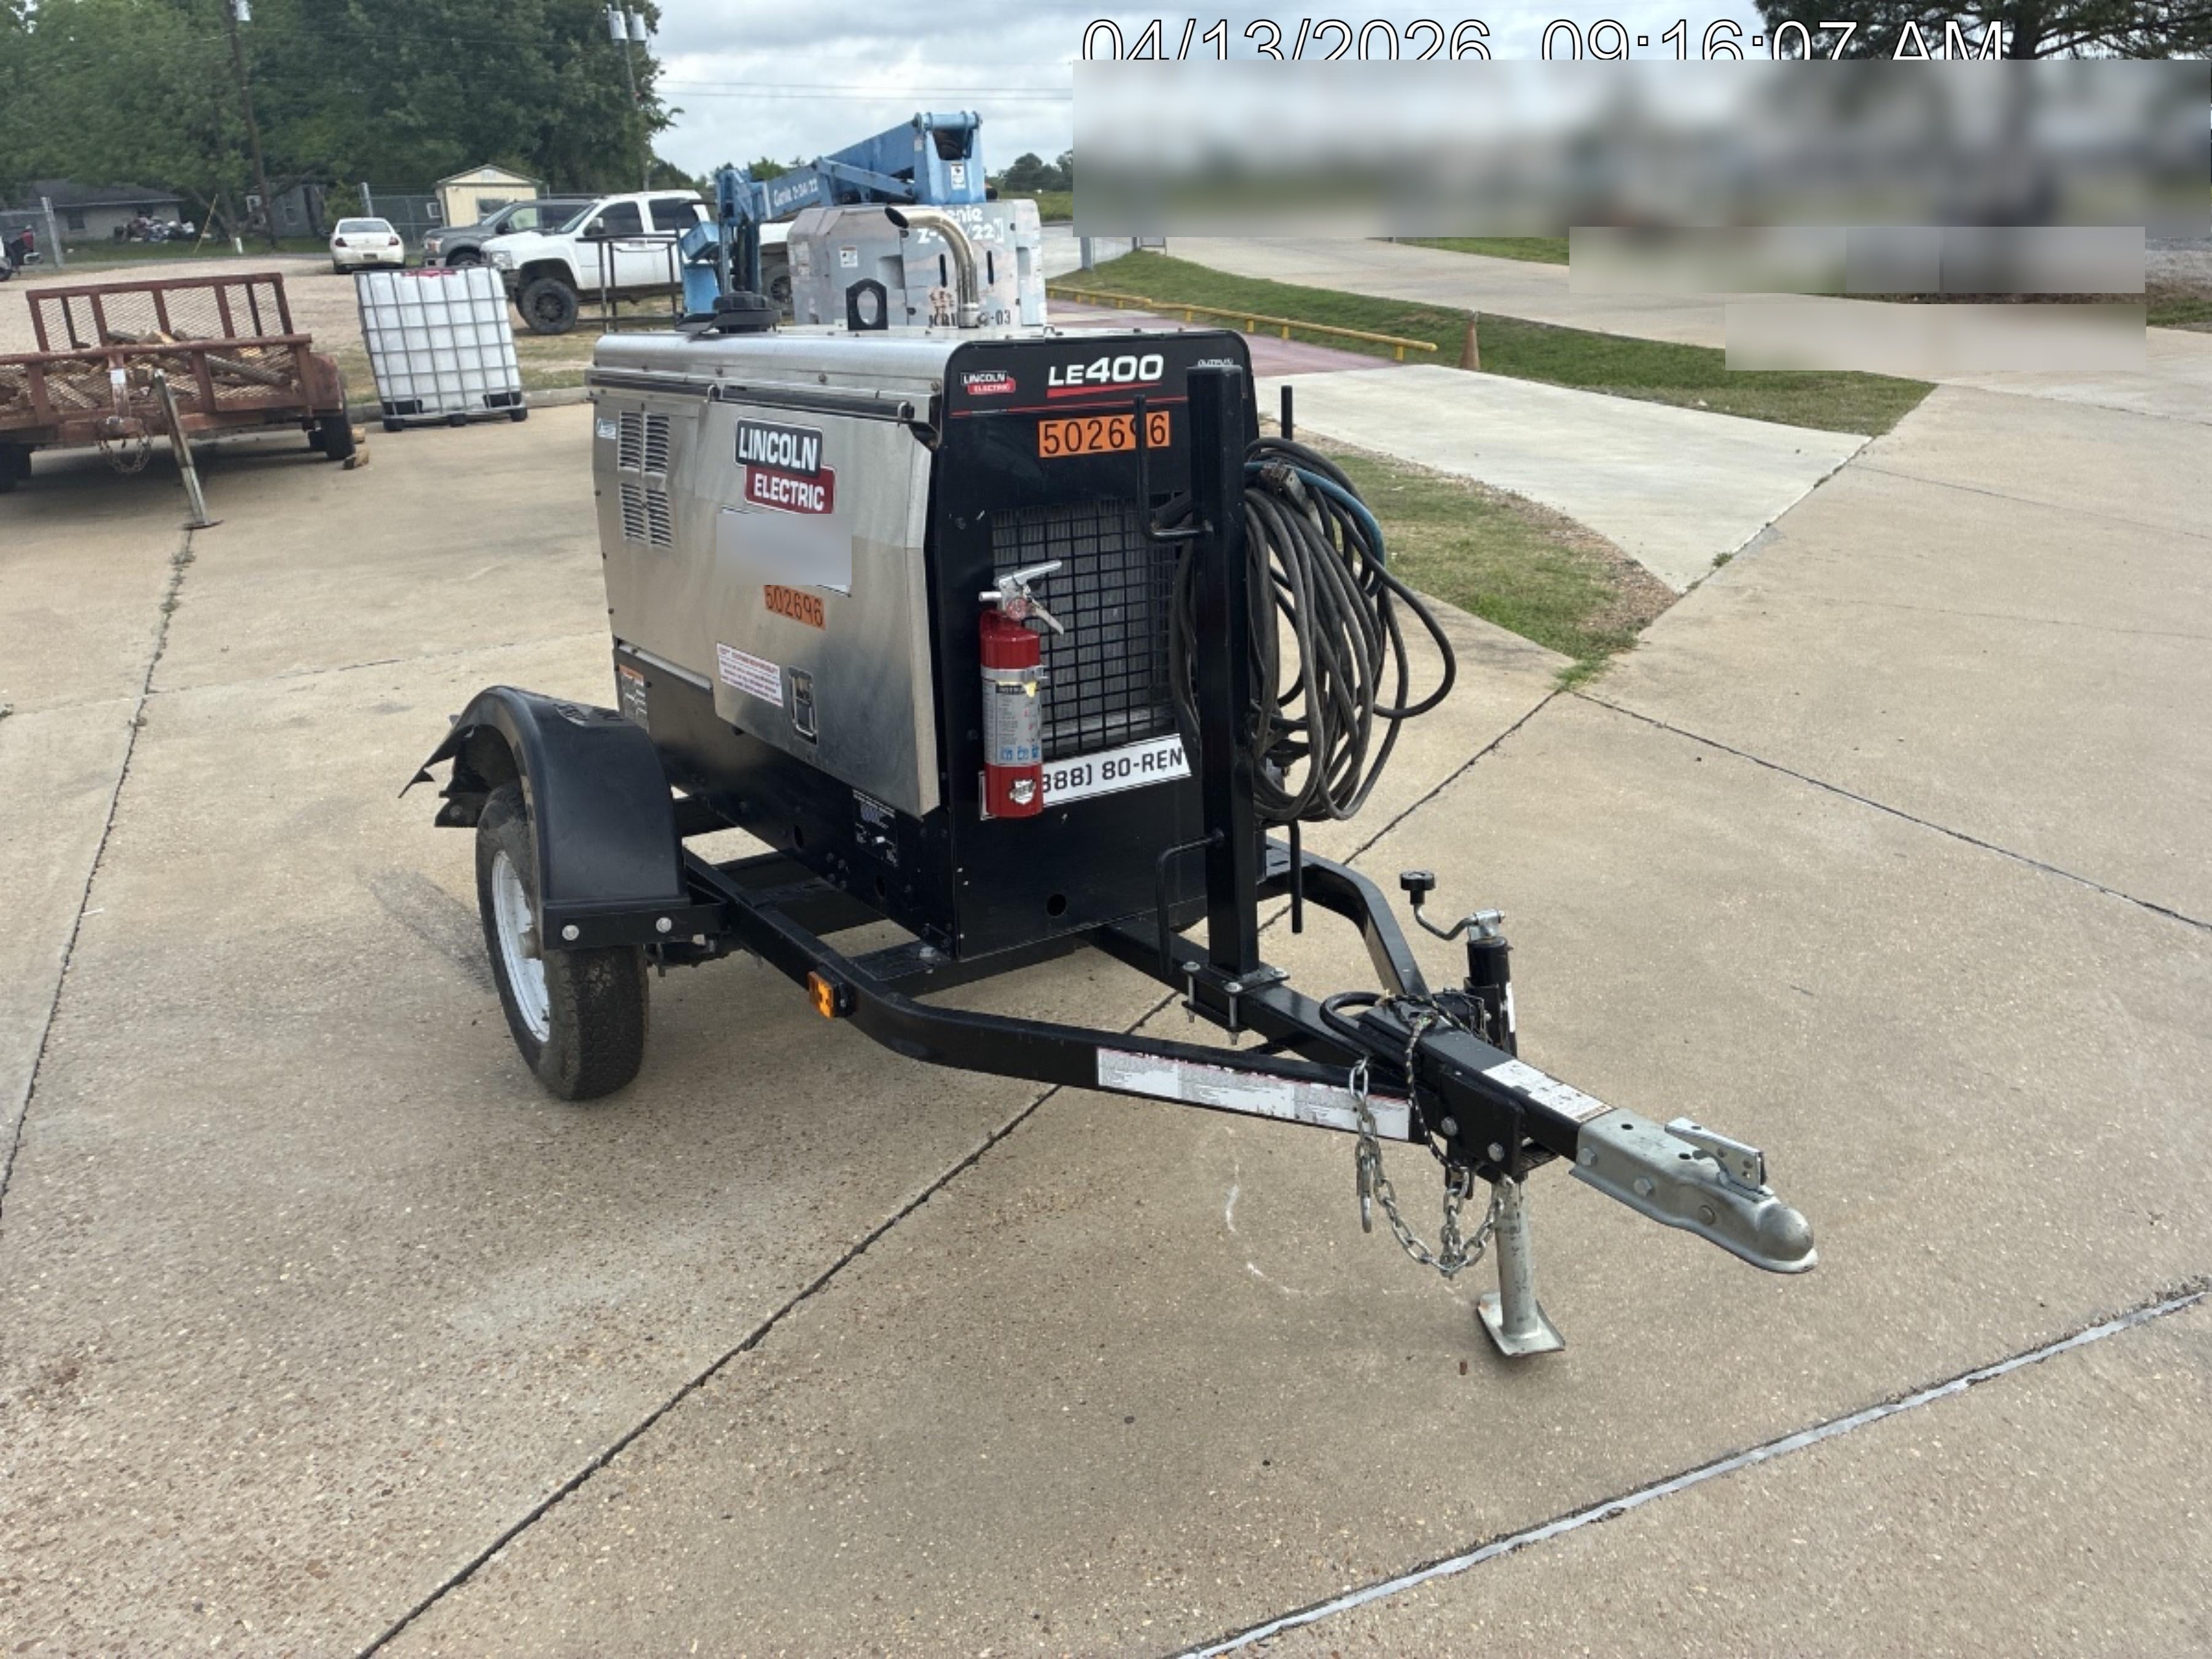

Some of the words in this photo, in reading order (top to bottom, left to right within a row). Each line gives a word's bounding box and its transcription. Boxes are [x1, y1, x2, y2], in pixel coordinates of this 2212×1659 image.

[963, 372, 1006, 384] LINCOLN
[1048, 354, 1163, 386] LE400
[739, 427, 818, 473] LINCOLN
[753, 473, 825, 511] ELECTRIC
[766, 585, 823, 627] 502696
[1043, 763, 1092, 793] 888)
